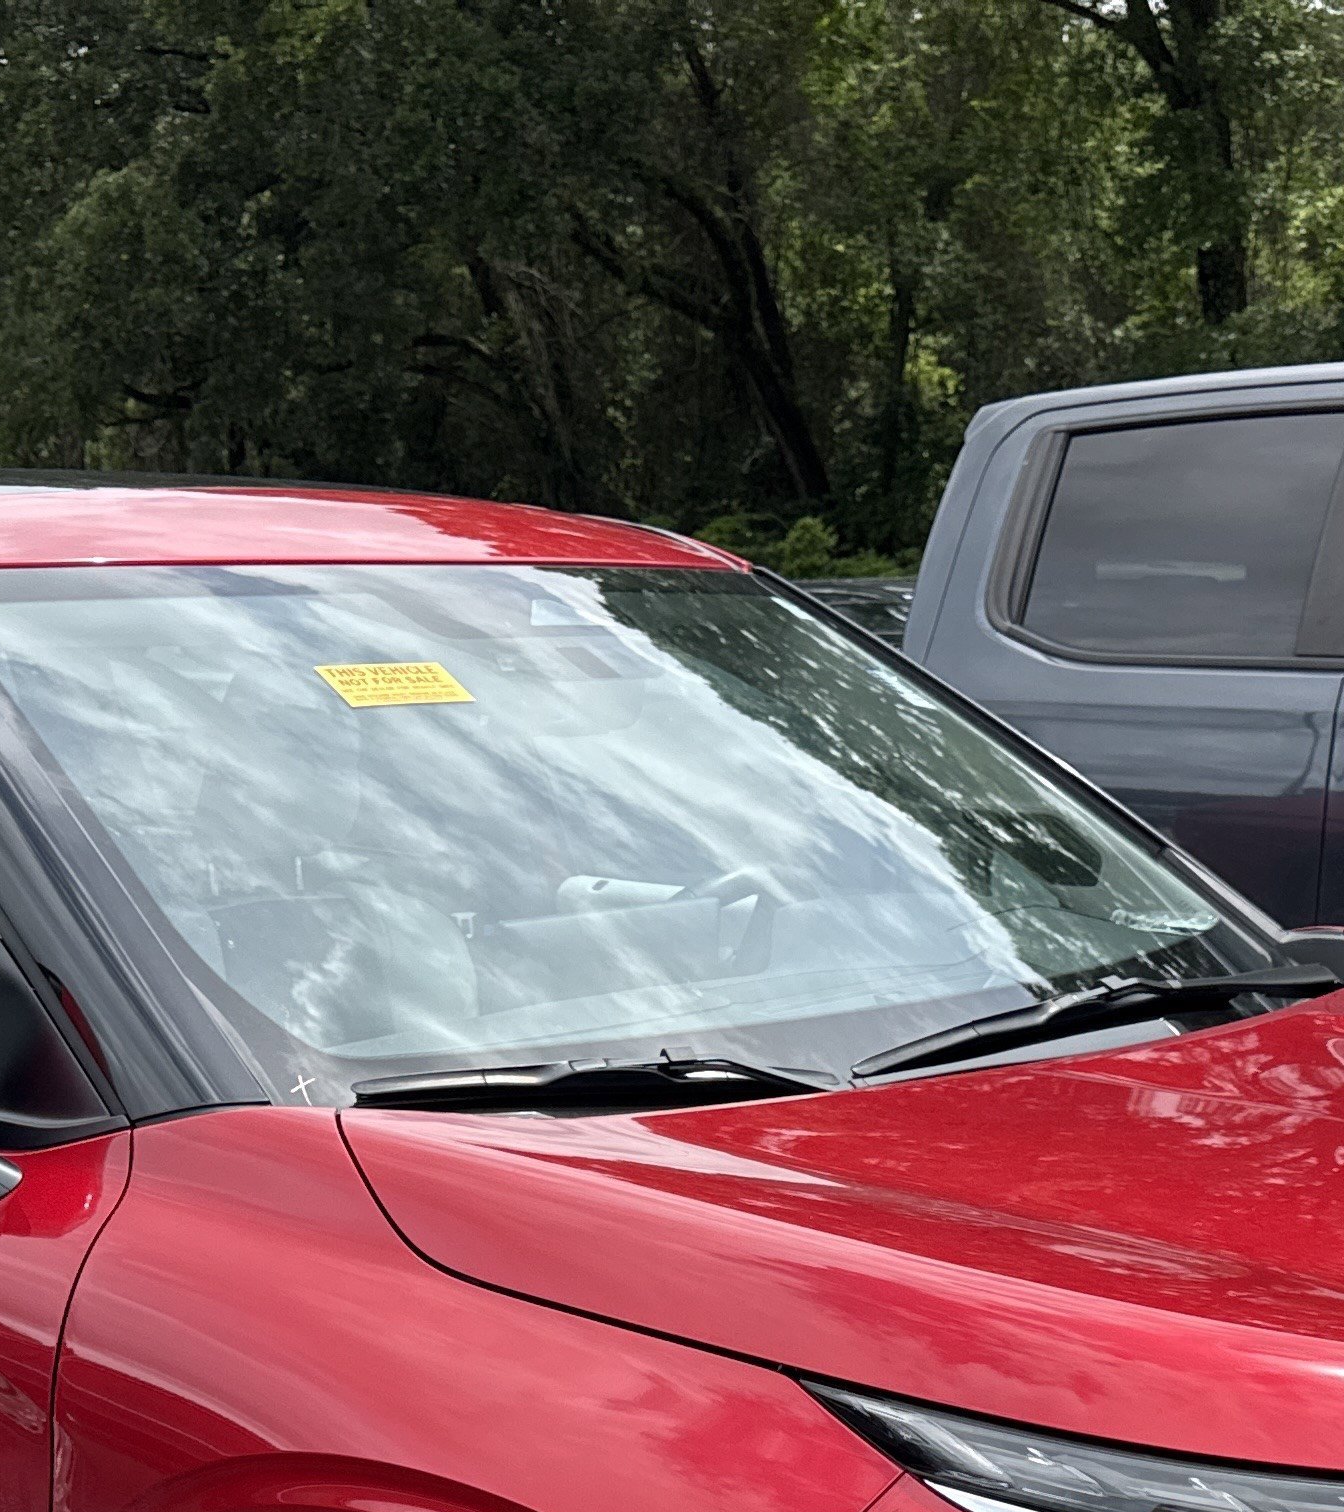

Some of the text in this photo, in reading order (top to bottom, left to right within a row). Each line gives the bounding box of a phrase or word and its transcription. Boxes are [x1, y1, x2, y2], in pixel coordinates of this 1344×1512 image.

[325, 665, 439, 678] THIS VEHICLE
[338, 675, 443, 687] NOT FOR SALE
